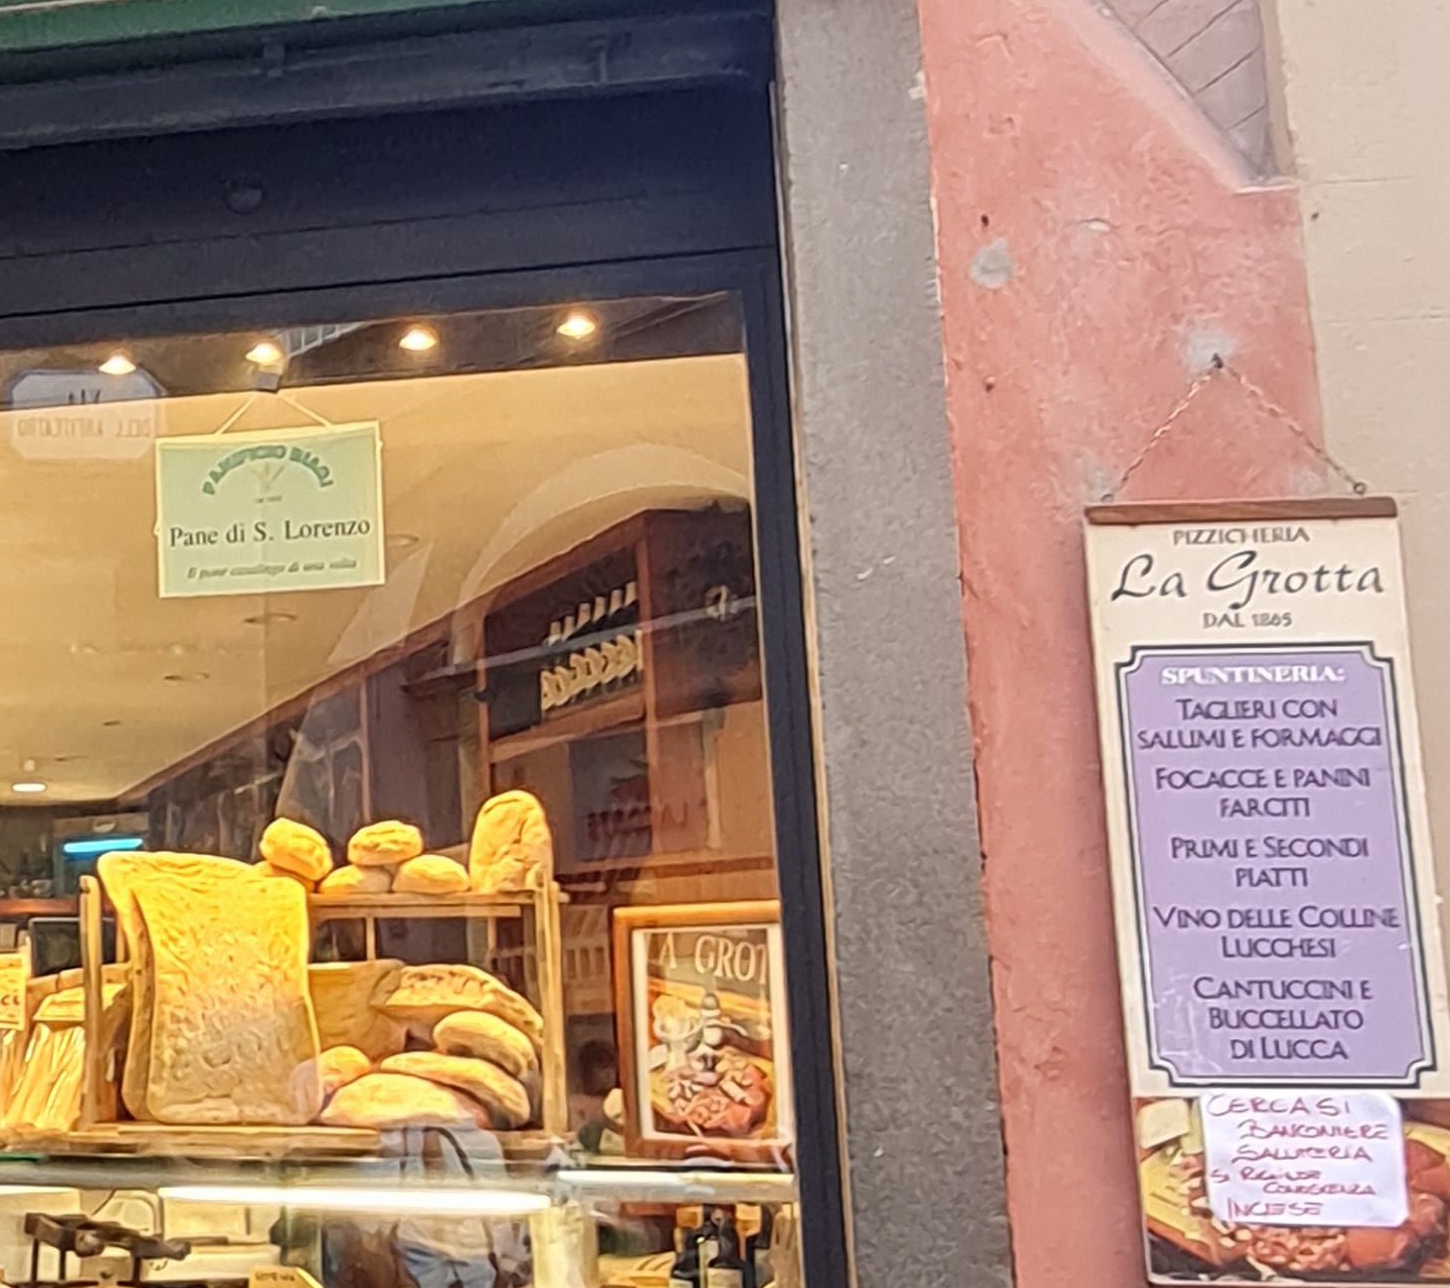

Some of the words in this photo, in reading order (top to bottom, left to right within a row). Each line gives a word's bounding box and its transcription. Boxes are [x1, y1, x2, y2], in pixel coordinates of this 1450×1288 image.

[170, 527, 218, 547] Pane
[225, 523, 246, 543] di
[253, 522, 274, 542] S.
[284, 519, 371, 540] Lorenzo
[1173, 526, 1310, 546] PIZZICHERIA
[1111, 554, 1188, 602] La
[1206, 550, 1385, 610] Grotta
[1202, 612, 1246, 628] DAL
[1161, 664, 1346, 685] SPUNTINERIA:
[1175, 698, 1276, 721] TAGLIERI
[1282, 699, 1338, 719] CON
[1137, 729, 1226, 749] SALUMI
[1233, 729, 1245, 748] E
[1251, 726, 1382, 749] FORMAGGI
[1155, 767, 1268, 790] FOCACCE
[1275, 768, 1286, 787] E
[1294, 767, 1371, 788] PANINI
[1219, 797, 1311, 818] FARCITI
[1171, 837, 1238, 859] PRIMI
[1246, 838, 1258, 857] E
[1263, 836, 1369, 858] SECONDI
[1236, 867, 1308, 888] PIATTI
[1153, 905, 1221, 928] VINO
[1228, 908, 1292, 928] DELLE
[1298, 905, 1400, 928] COLLINE
[1222, 936, 1336, 958] LUCCHESI
[1193, 976, 1353, 1000] CANTUCCINI
[1360, 980, 1372, 999] E
[1208, 1008, 1364, 1031] BUCCELLATO
[1230, 1039, 1255, 1059] DI
[1260, 1036, 1349, 1060] LUCCA
